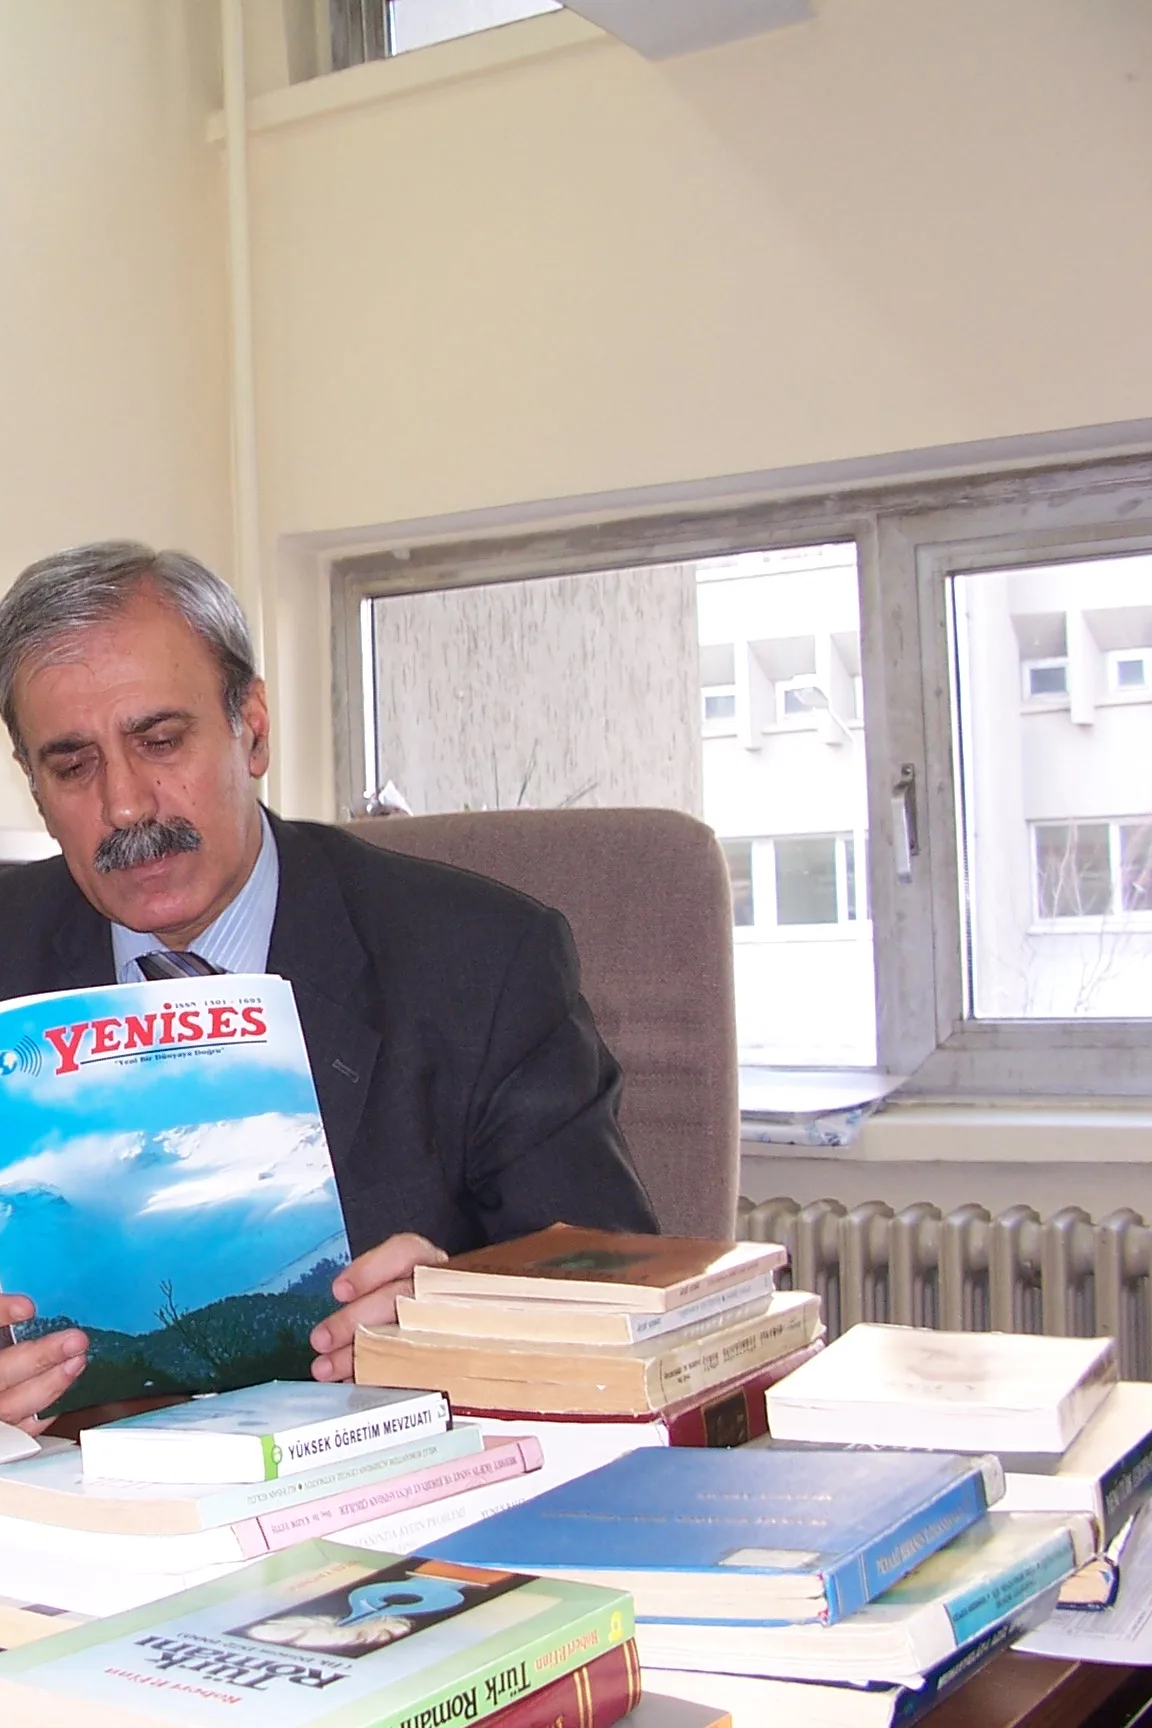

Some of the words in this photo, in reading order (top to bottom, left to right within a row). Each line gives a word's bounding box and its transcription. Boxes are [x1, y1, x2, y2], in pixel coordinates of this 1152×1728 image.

[45, 1003, 267, 1075] YENİSES
[288, 1436, 332, 1460] YÜKSEK
[334, 1422, 381, 1448] ÖĞRETİM
[383, 1409, 432, 1435] MEVZUATI
[134, 1635, 351, 1689] Romanı
[144, 1652, 269, 1691] Türk
[484, 1661, 531, 1706] Türk
